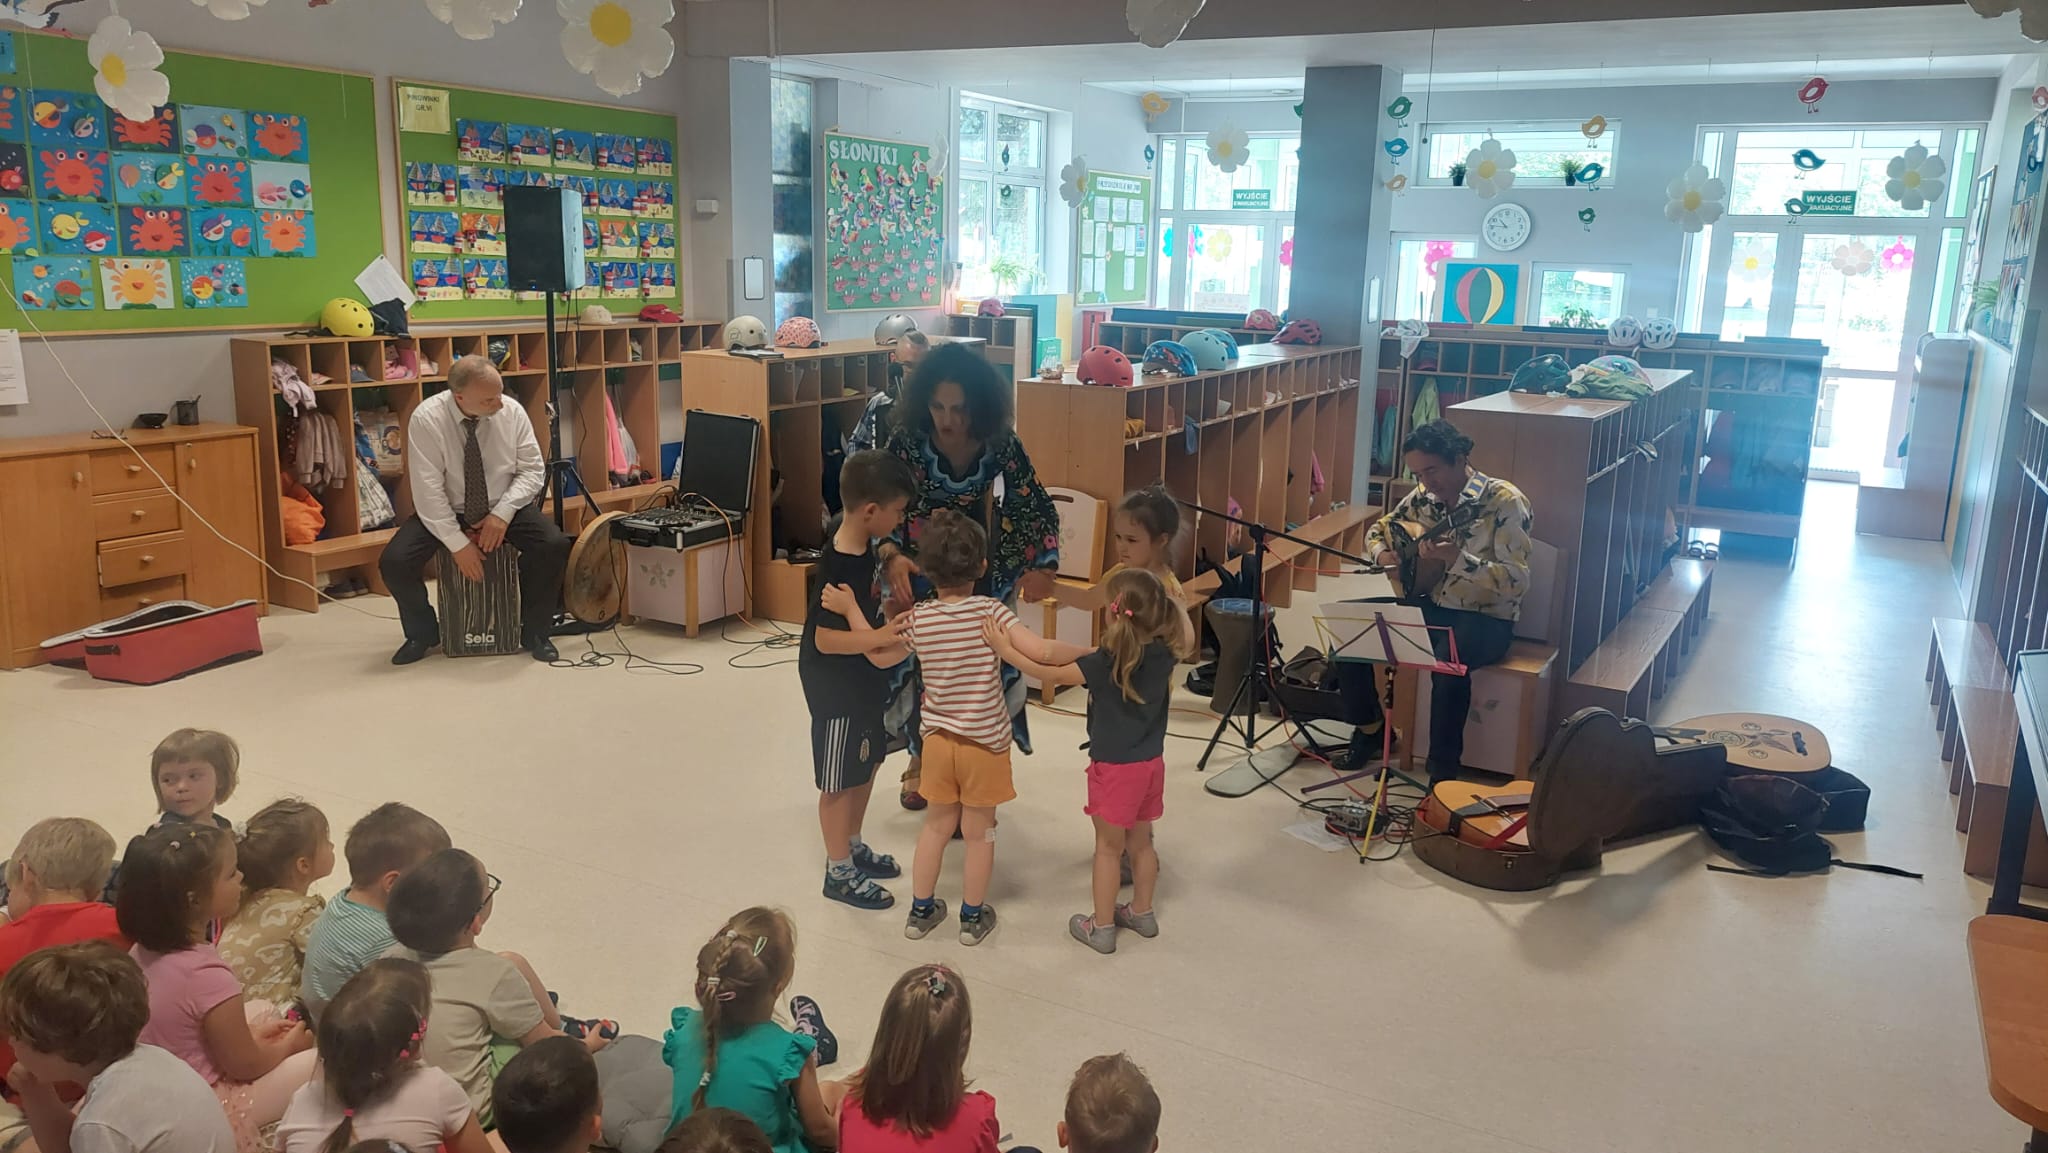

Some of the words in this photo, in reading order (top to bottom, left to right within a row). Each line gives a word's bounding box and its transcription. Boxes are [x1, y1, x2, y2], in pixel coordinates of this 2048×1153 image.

[829, 139, 898, 166] SŁONIKI
[1806, 193, 1852, 203] WYJŚCIE
[465, 633, 495, 644] Sela
